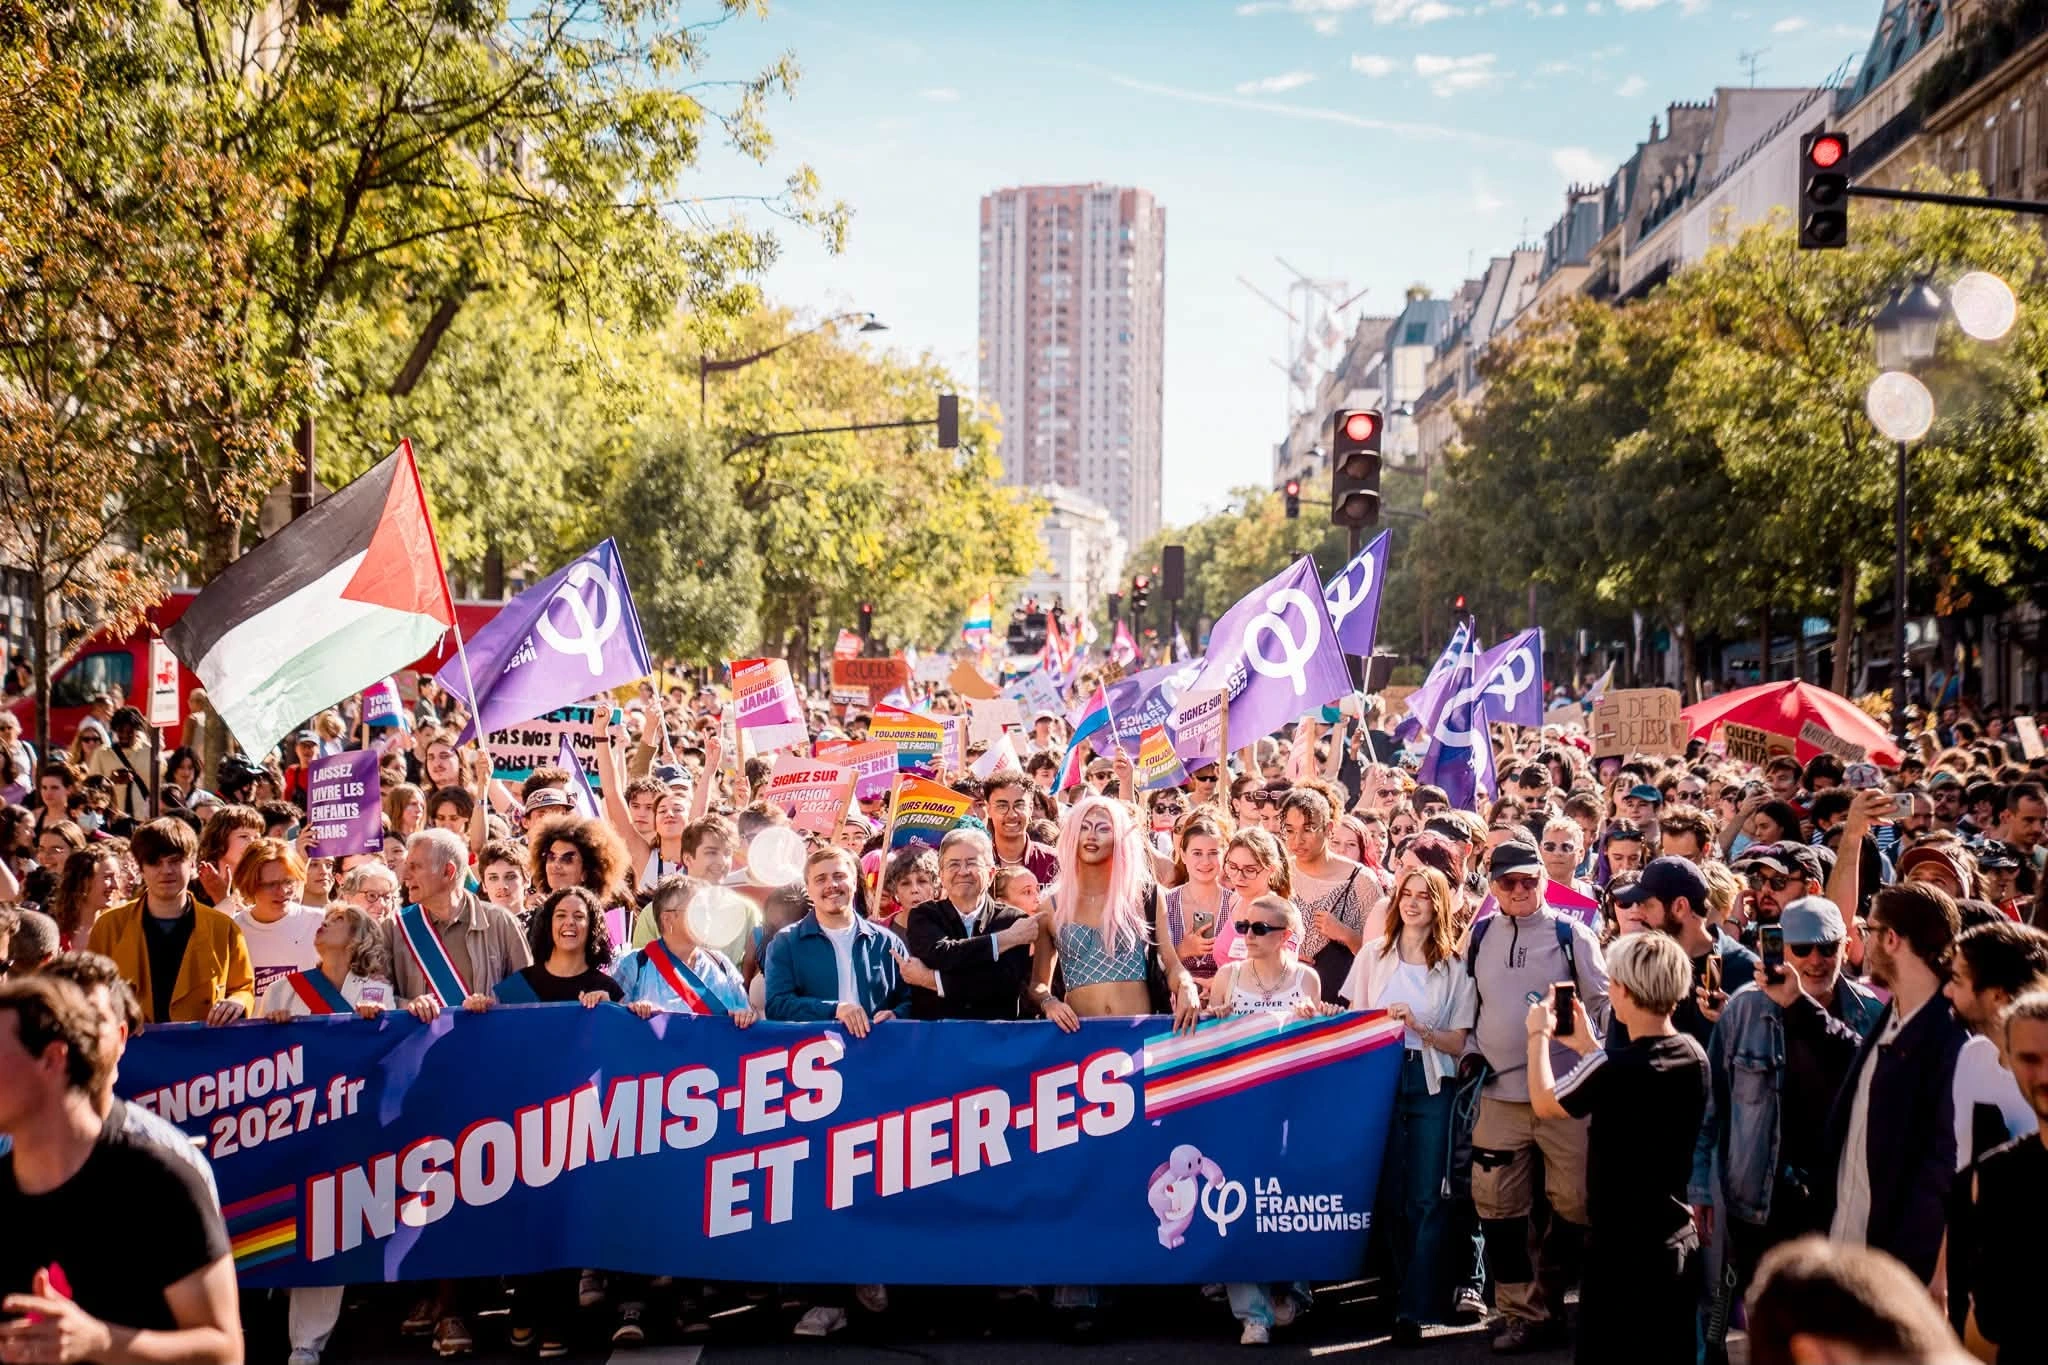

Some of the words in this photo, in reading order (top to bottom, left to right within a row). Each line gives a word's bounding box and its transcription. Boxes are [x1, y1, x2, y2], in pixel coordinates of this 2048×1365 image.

[1179, 702, 1208, 725] SIGNEZ
[1209, 694, 1222, 711] SUR
[522, 731, 552, 746] NOS
[875, 731, 915, 739] TOUJOURS
[1726, 726, 1767, 743] QUEER
[527, 755, 547, 767] LE
[313, 763, 353, 784] LAISSEZ
[772, 771, 811, 788] SIGNEZ
[812, 770, 838, 783] SUR
[312, 784, 342, 803] VIVRE
[343, 782, 364, 798] LES
[312, 803, 361, 821] ENFANTS
[921, 801, 956, 815] HOMO,
[908, 814, 944, 826] FACHO
[211, 1074, 366, 1160] 2027.fr
[706, 1138, 810, 1238] ET
[1254, 1177, 1282, 1195] LA
[1255, 1195, 1344, 1214] FRANCE
[1256, 1212, 1371, 1233] INSOUMISE
